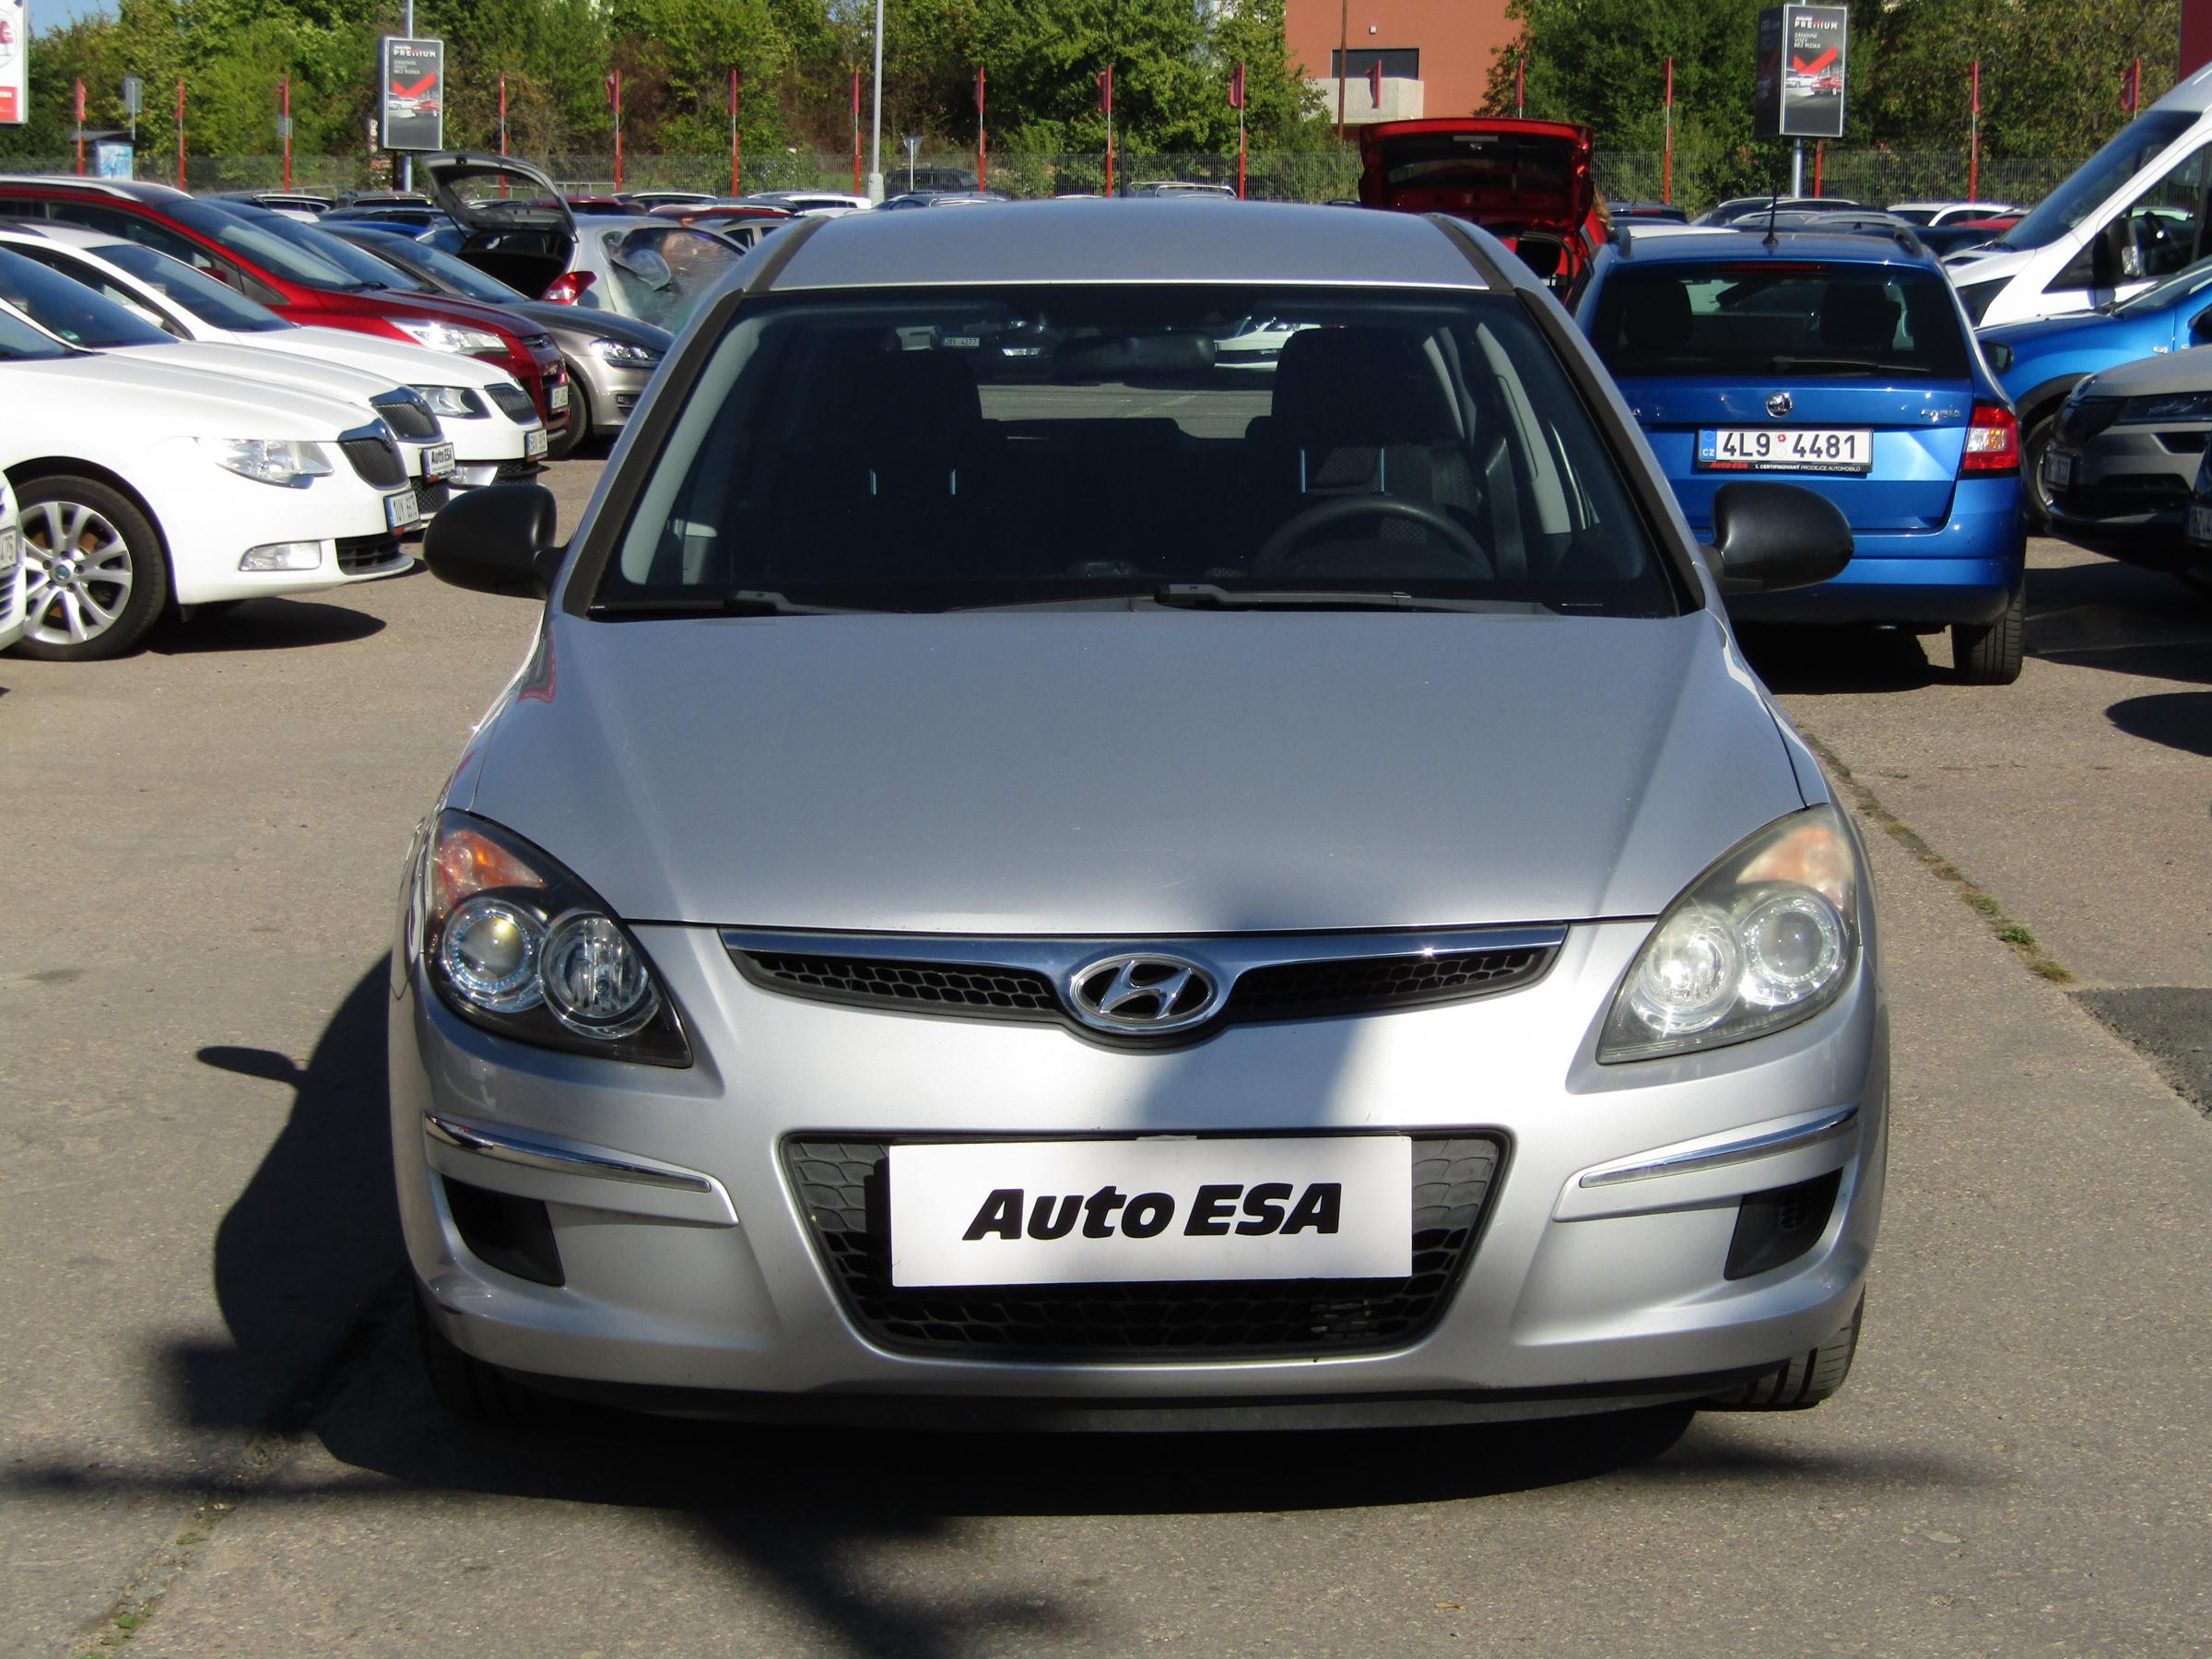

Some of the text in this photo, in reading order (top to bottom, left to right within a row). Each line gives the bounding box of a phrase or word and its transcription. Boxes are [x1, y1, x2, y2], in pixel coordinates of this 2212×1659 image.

[1702, 432, 1855, 460] CZ 4L9 4481
[961, 1182, 1342, 1241] Auto ESA
